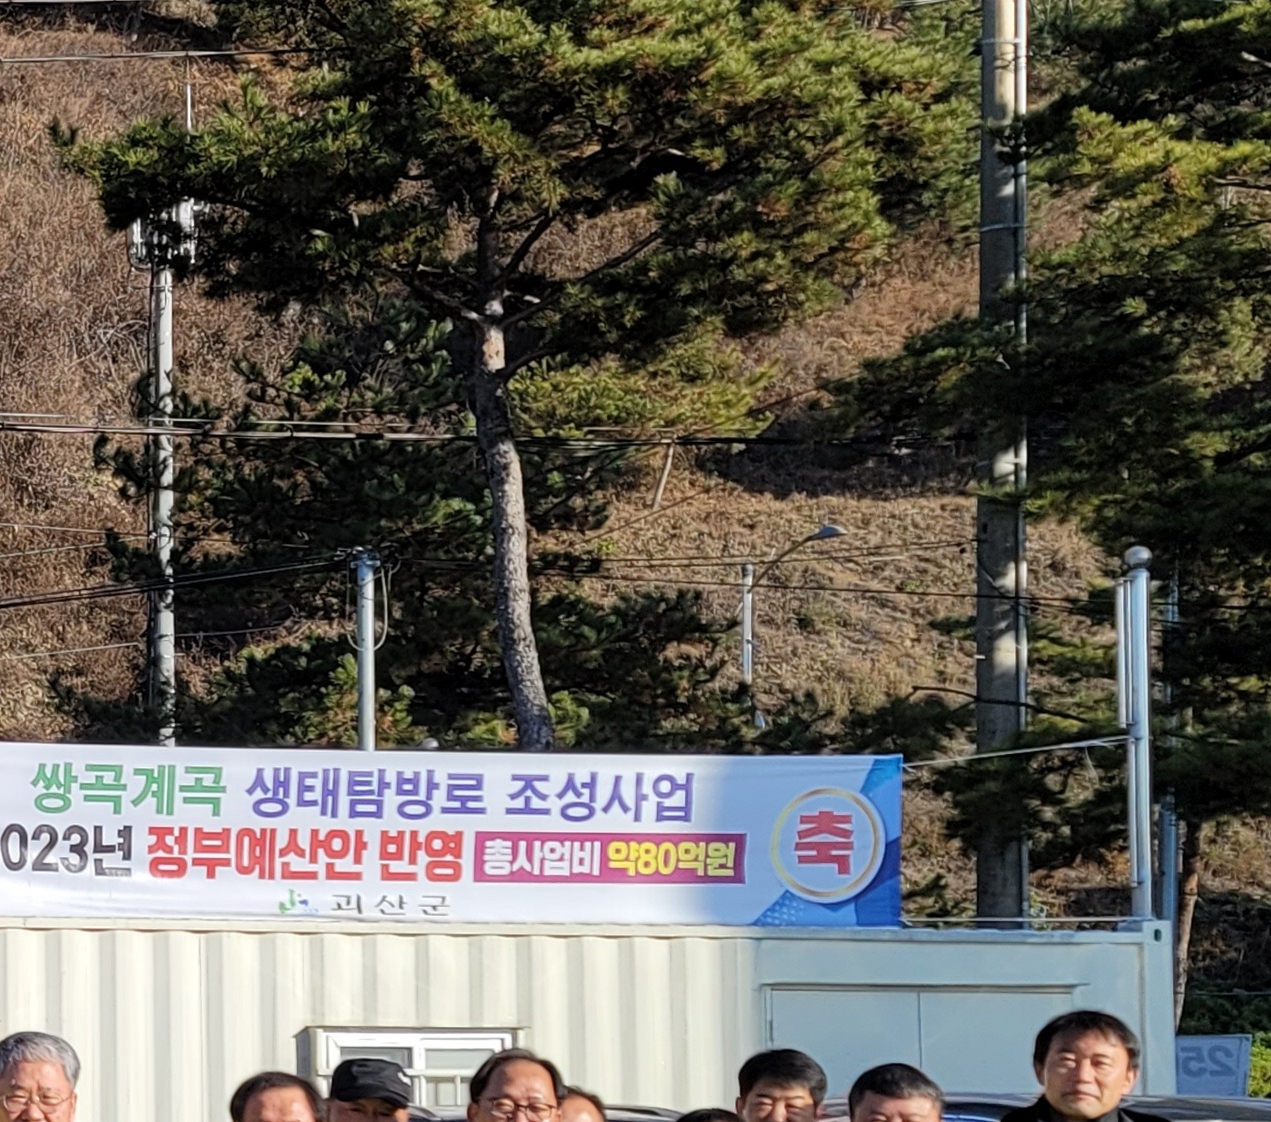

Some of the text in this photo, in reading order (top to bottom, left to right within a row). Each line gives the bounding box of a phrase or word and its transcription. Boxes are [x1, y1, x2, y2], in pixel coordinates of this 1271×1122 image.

[30, 762, 696, 823] 쌍곡계곡 생태탐방로 조성사업
[147, 826, 368, 881] 정부예산안
[379, 829, 465, 882] 반영
[482, 838, 602, 877] 총사업비
[607, 840, 736, 877] 약80억원
[794, 810, 854, 876] 축
[331, 894, 451, 916] 괴산군
